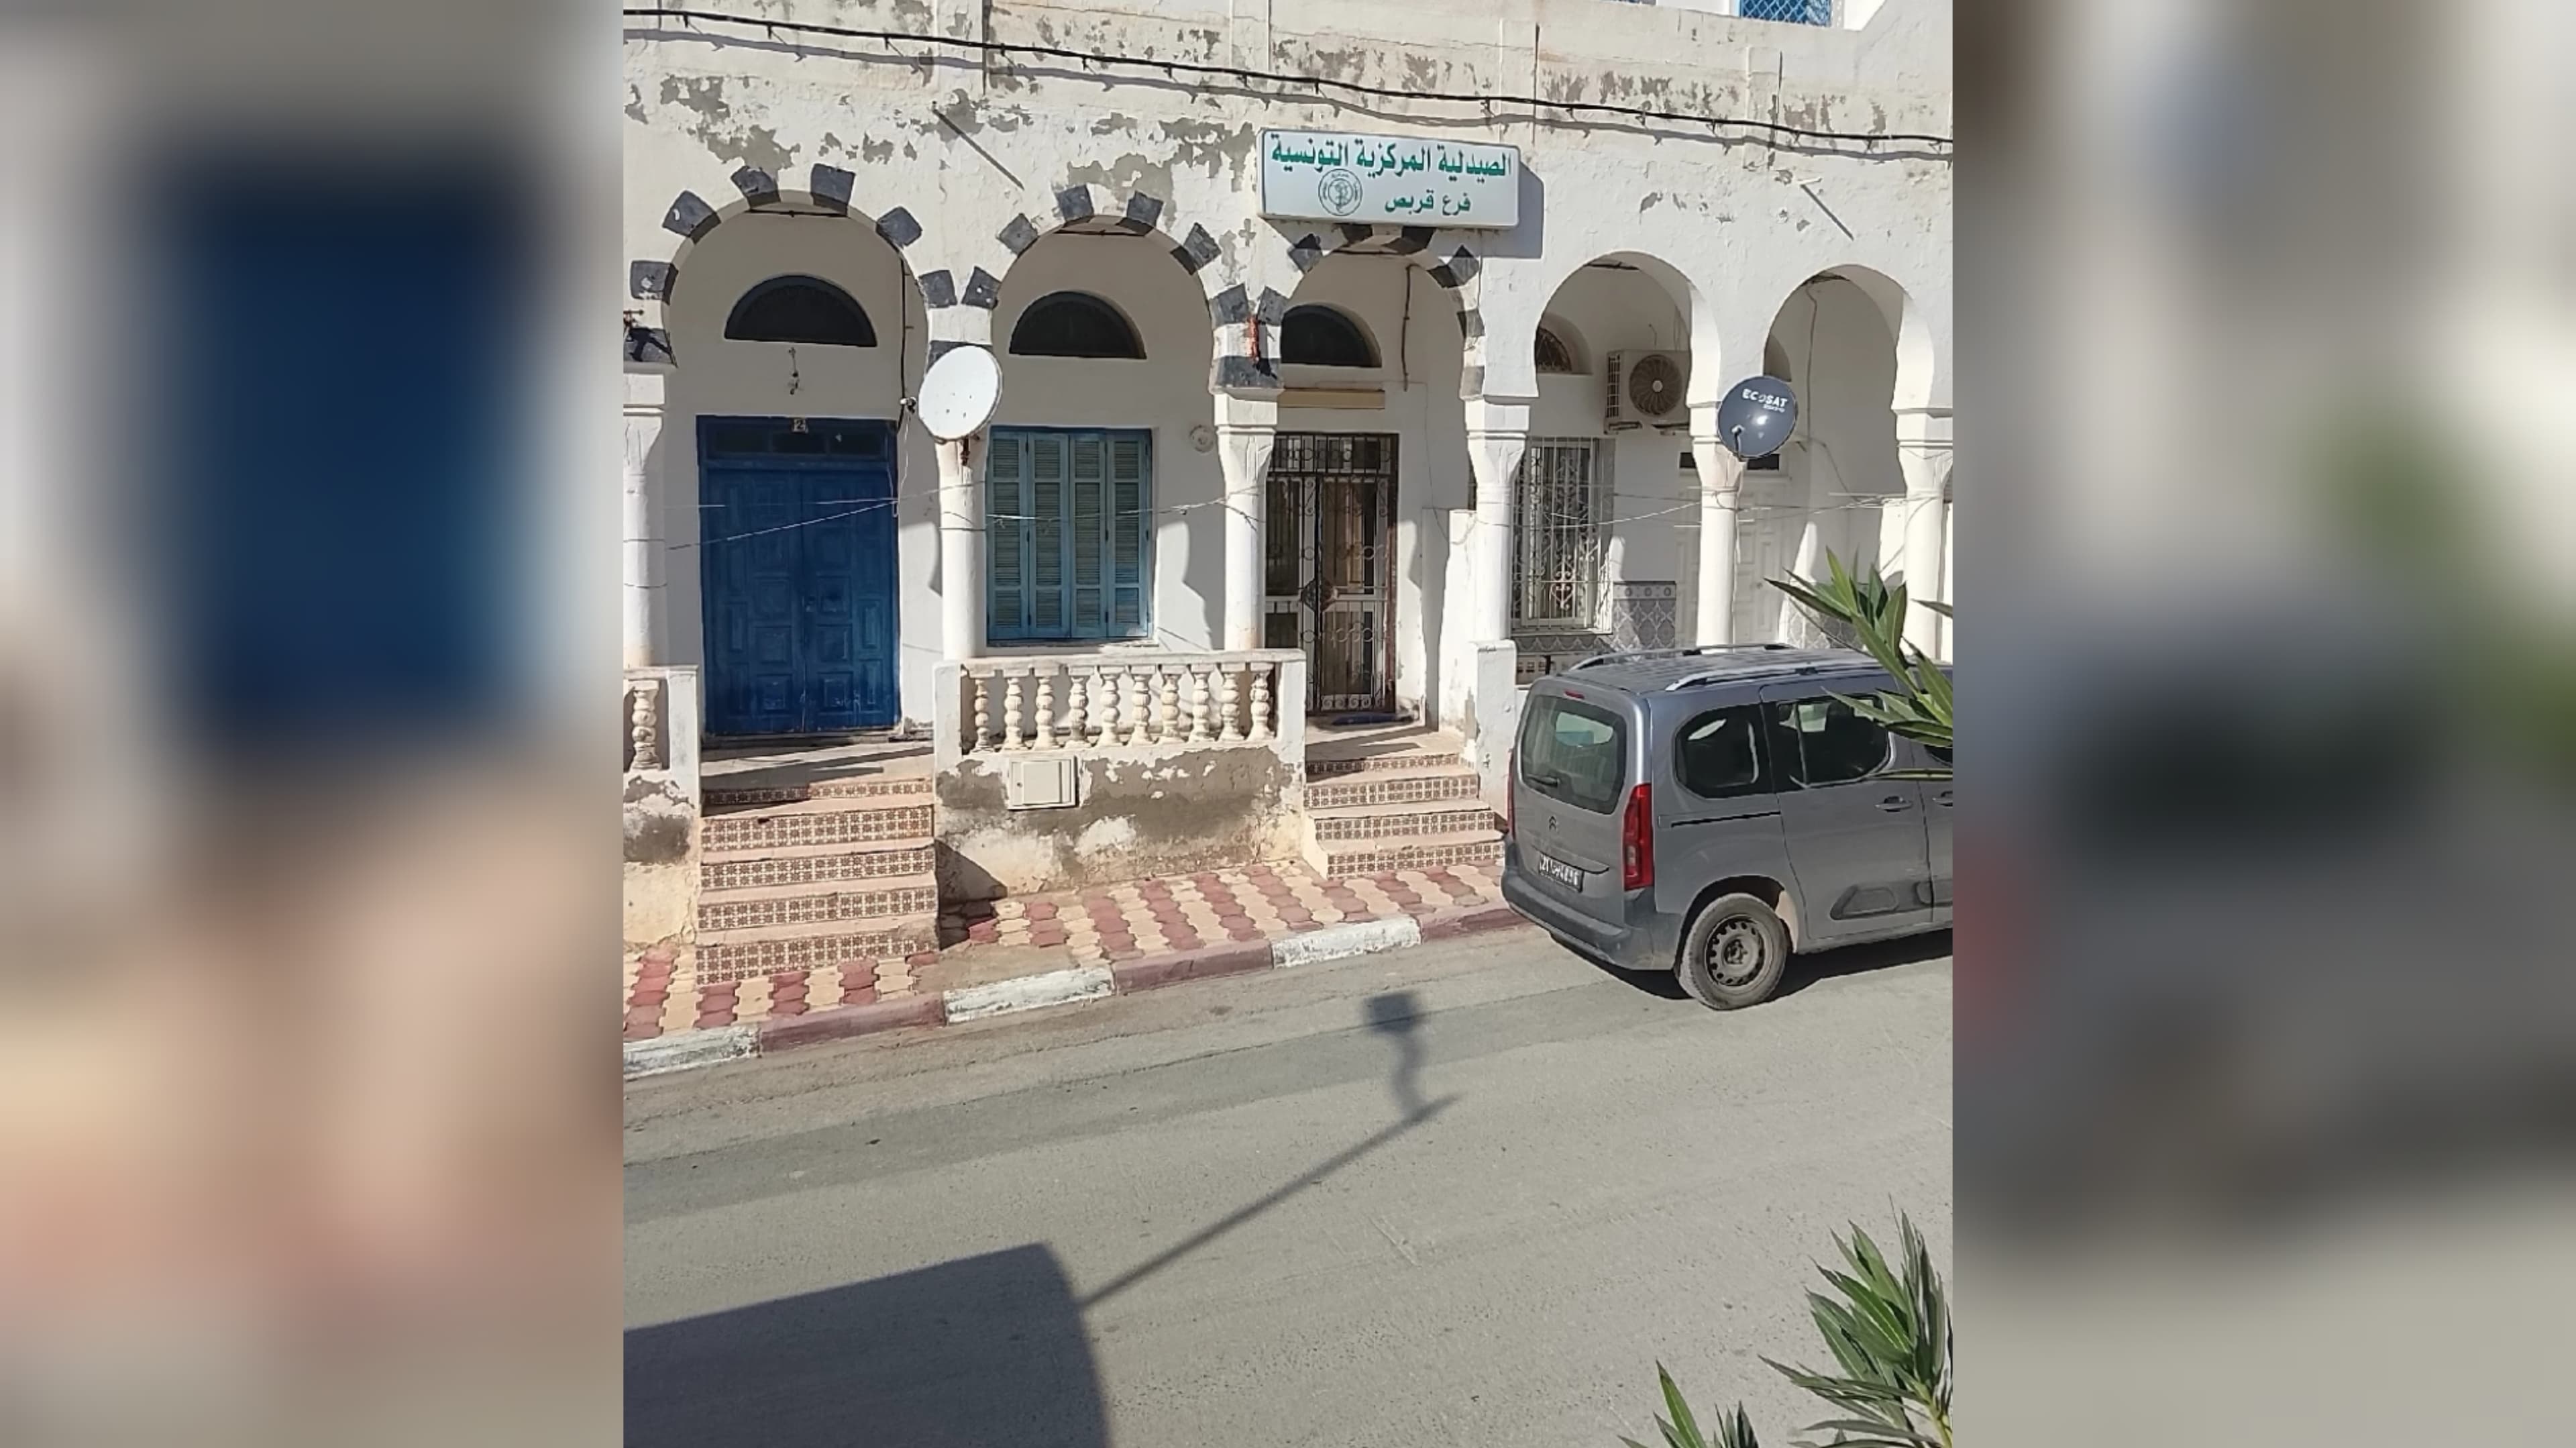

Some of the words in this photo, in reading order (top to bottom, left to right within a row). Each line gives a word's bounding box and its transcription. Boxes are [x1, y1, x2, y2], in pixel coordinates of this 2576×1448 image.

[1271, 134, 1348, 173] التونسية
[1354, 138, 1431, 178] المركزية
[1437, 144, 1512, 184] الصيدلية
[1385, 189, 1434, 215] قربص
[1442, 192, 1472, 215] فرع
[1742, 389, 1788, 407] ECOSAT
